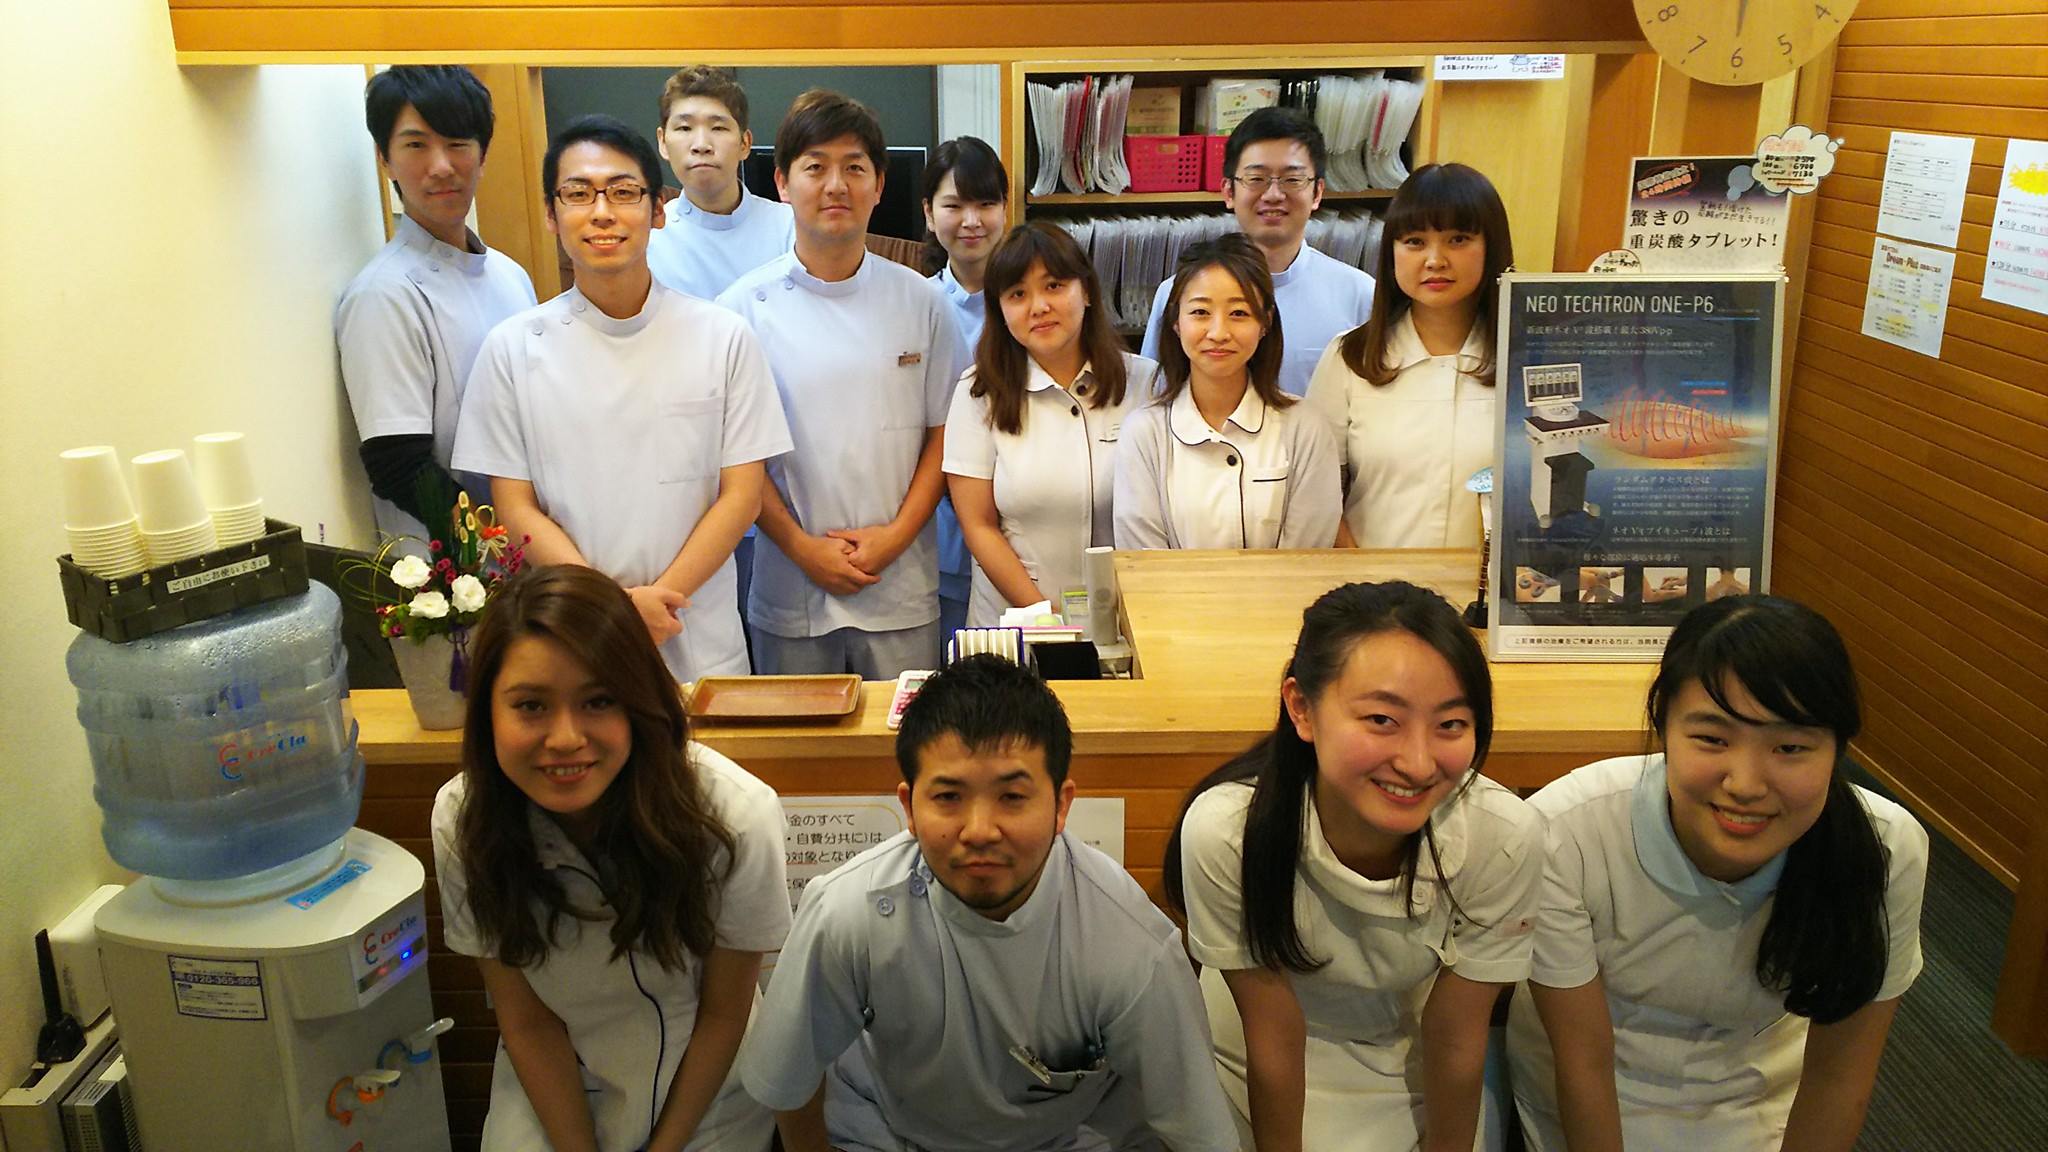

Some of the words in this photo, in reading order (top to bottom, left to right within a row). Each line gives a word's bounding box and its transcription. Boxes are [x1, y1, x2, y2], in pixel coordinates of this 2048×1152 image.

[1658, 5, 1679, 22] 8
[1816, 4, 1831, 20] 4
[1688, 35, 1708, 54] 7
[1777, 33, 1793, 55] 5
[1730, 47, 1744, 68] 6
[1630, 209, 1690, 227] 驚きの
[1630, 232, 1778, 249] 重炭酸タブレット!
[1526, 295, 1558, 313] NEO
[1564, 295, 1646, 313] TECHTRON
[1651, 295, 1715, 313] ONE-P6
[786, 814, 856, 827] 金のすべて
